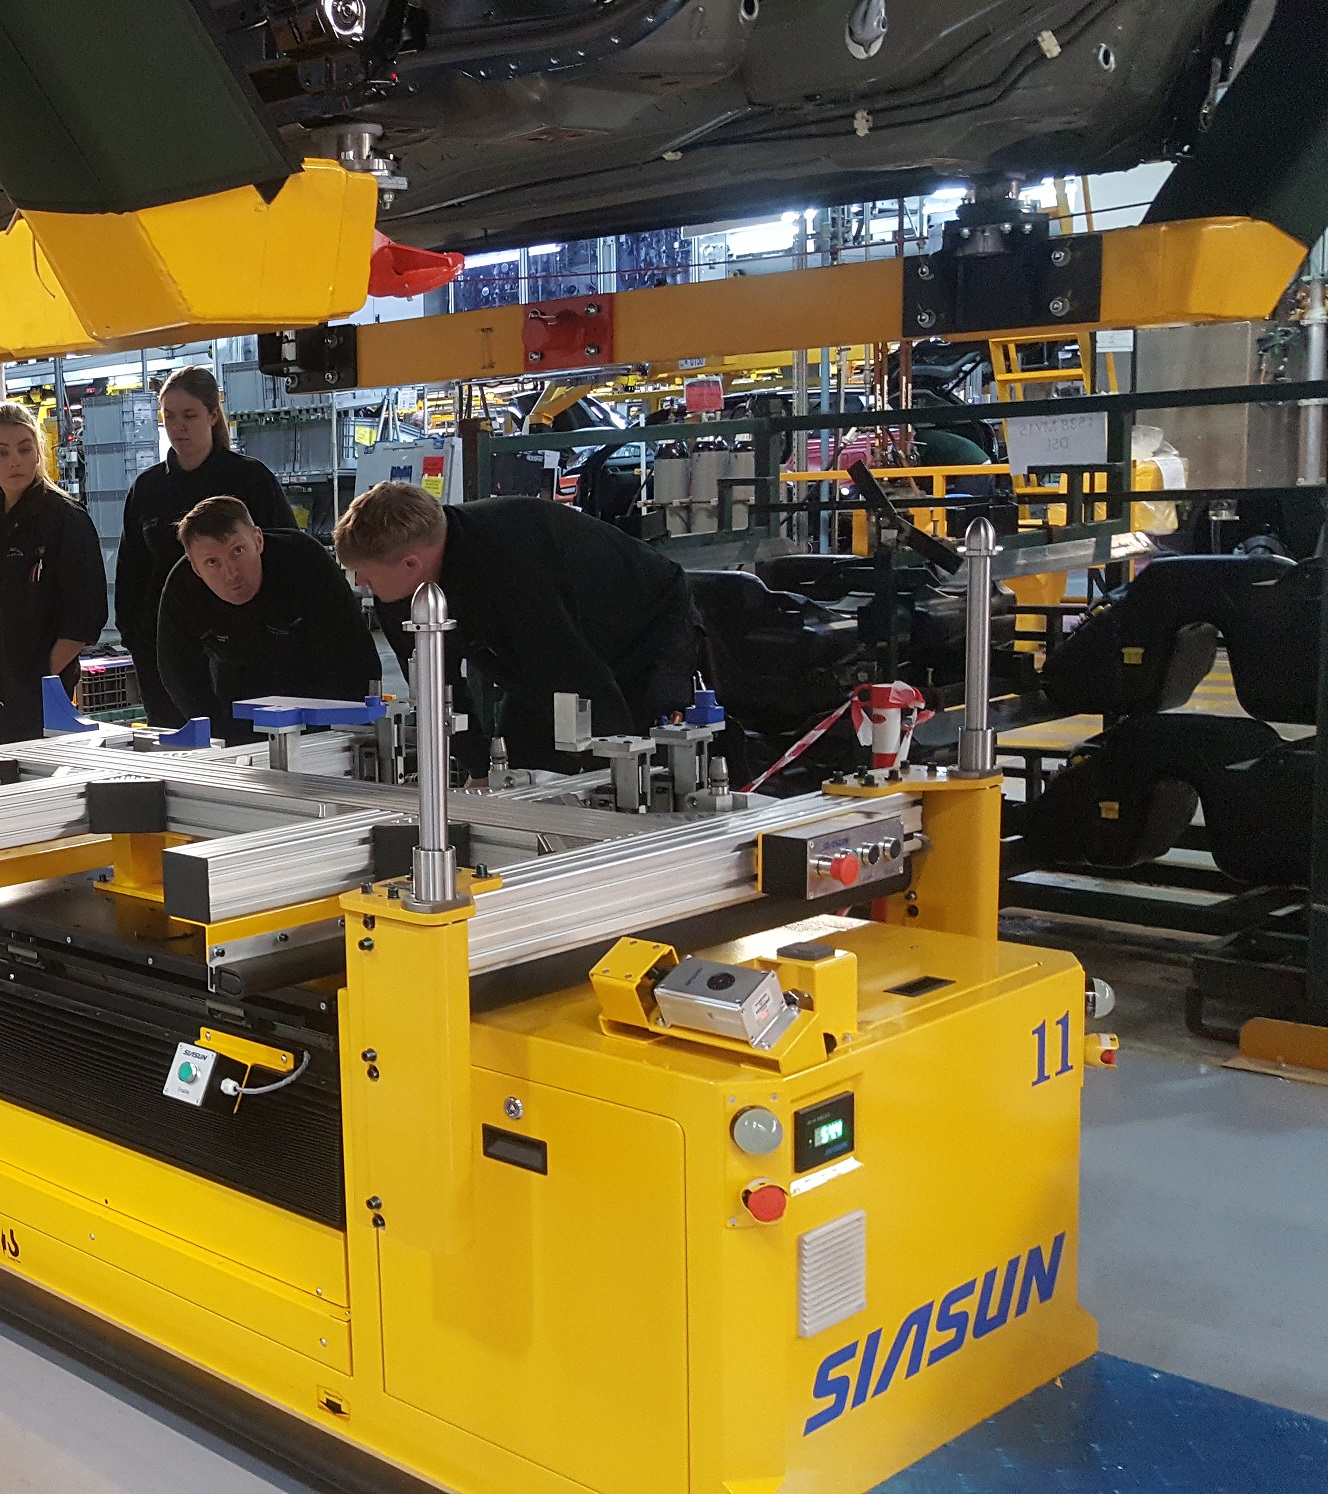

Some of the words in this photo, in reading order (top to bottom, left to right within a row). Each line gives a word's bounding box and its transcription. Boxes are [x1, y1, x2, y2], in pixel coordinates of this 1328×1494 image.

[183, 1050, 208, 1061] SIASUN
[1031, 1010, 1074, 1087] 11
[803, 1230, 1066, 1438] SIASUN
